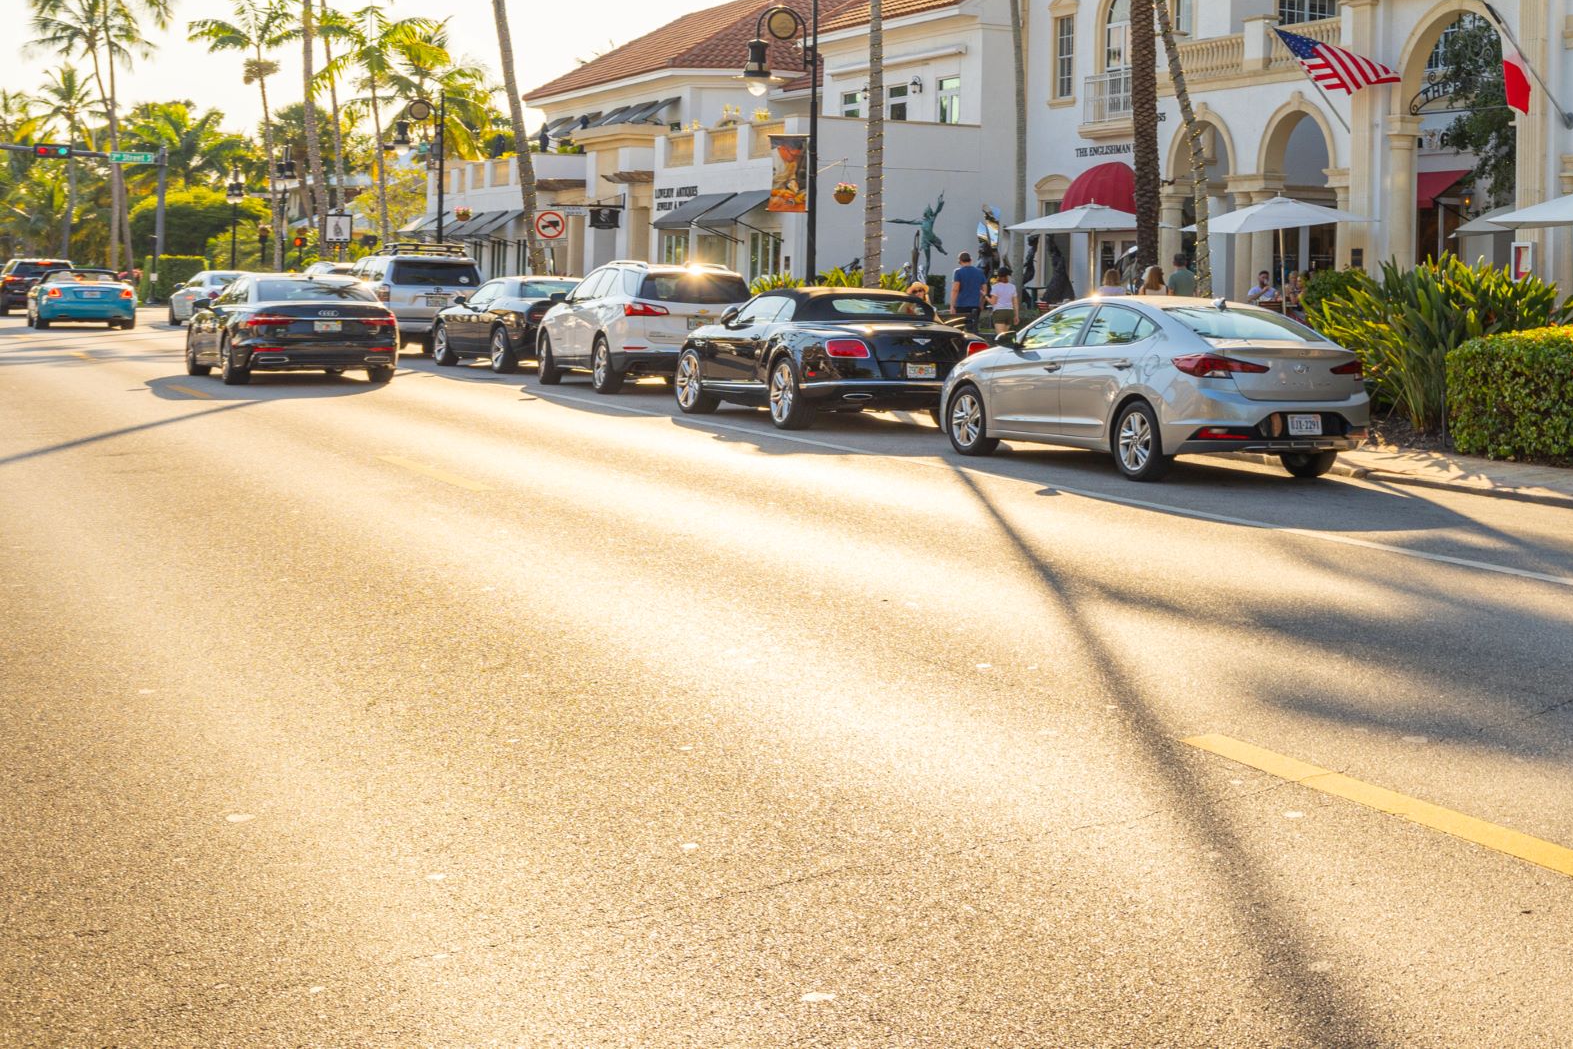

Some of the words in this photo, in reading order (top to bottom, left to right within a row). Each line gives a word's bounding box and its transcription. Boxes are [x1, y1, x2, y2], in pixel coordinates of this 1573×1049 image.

[1075, 147, 1088, 157] THE
[1089, 143, 1131, 156] ENGLISHMAN
[676, 185, 698, 197] ANTIQUES
